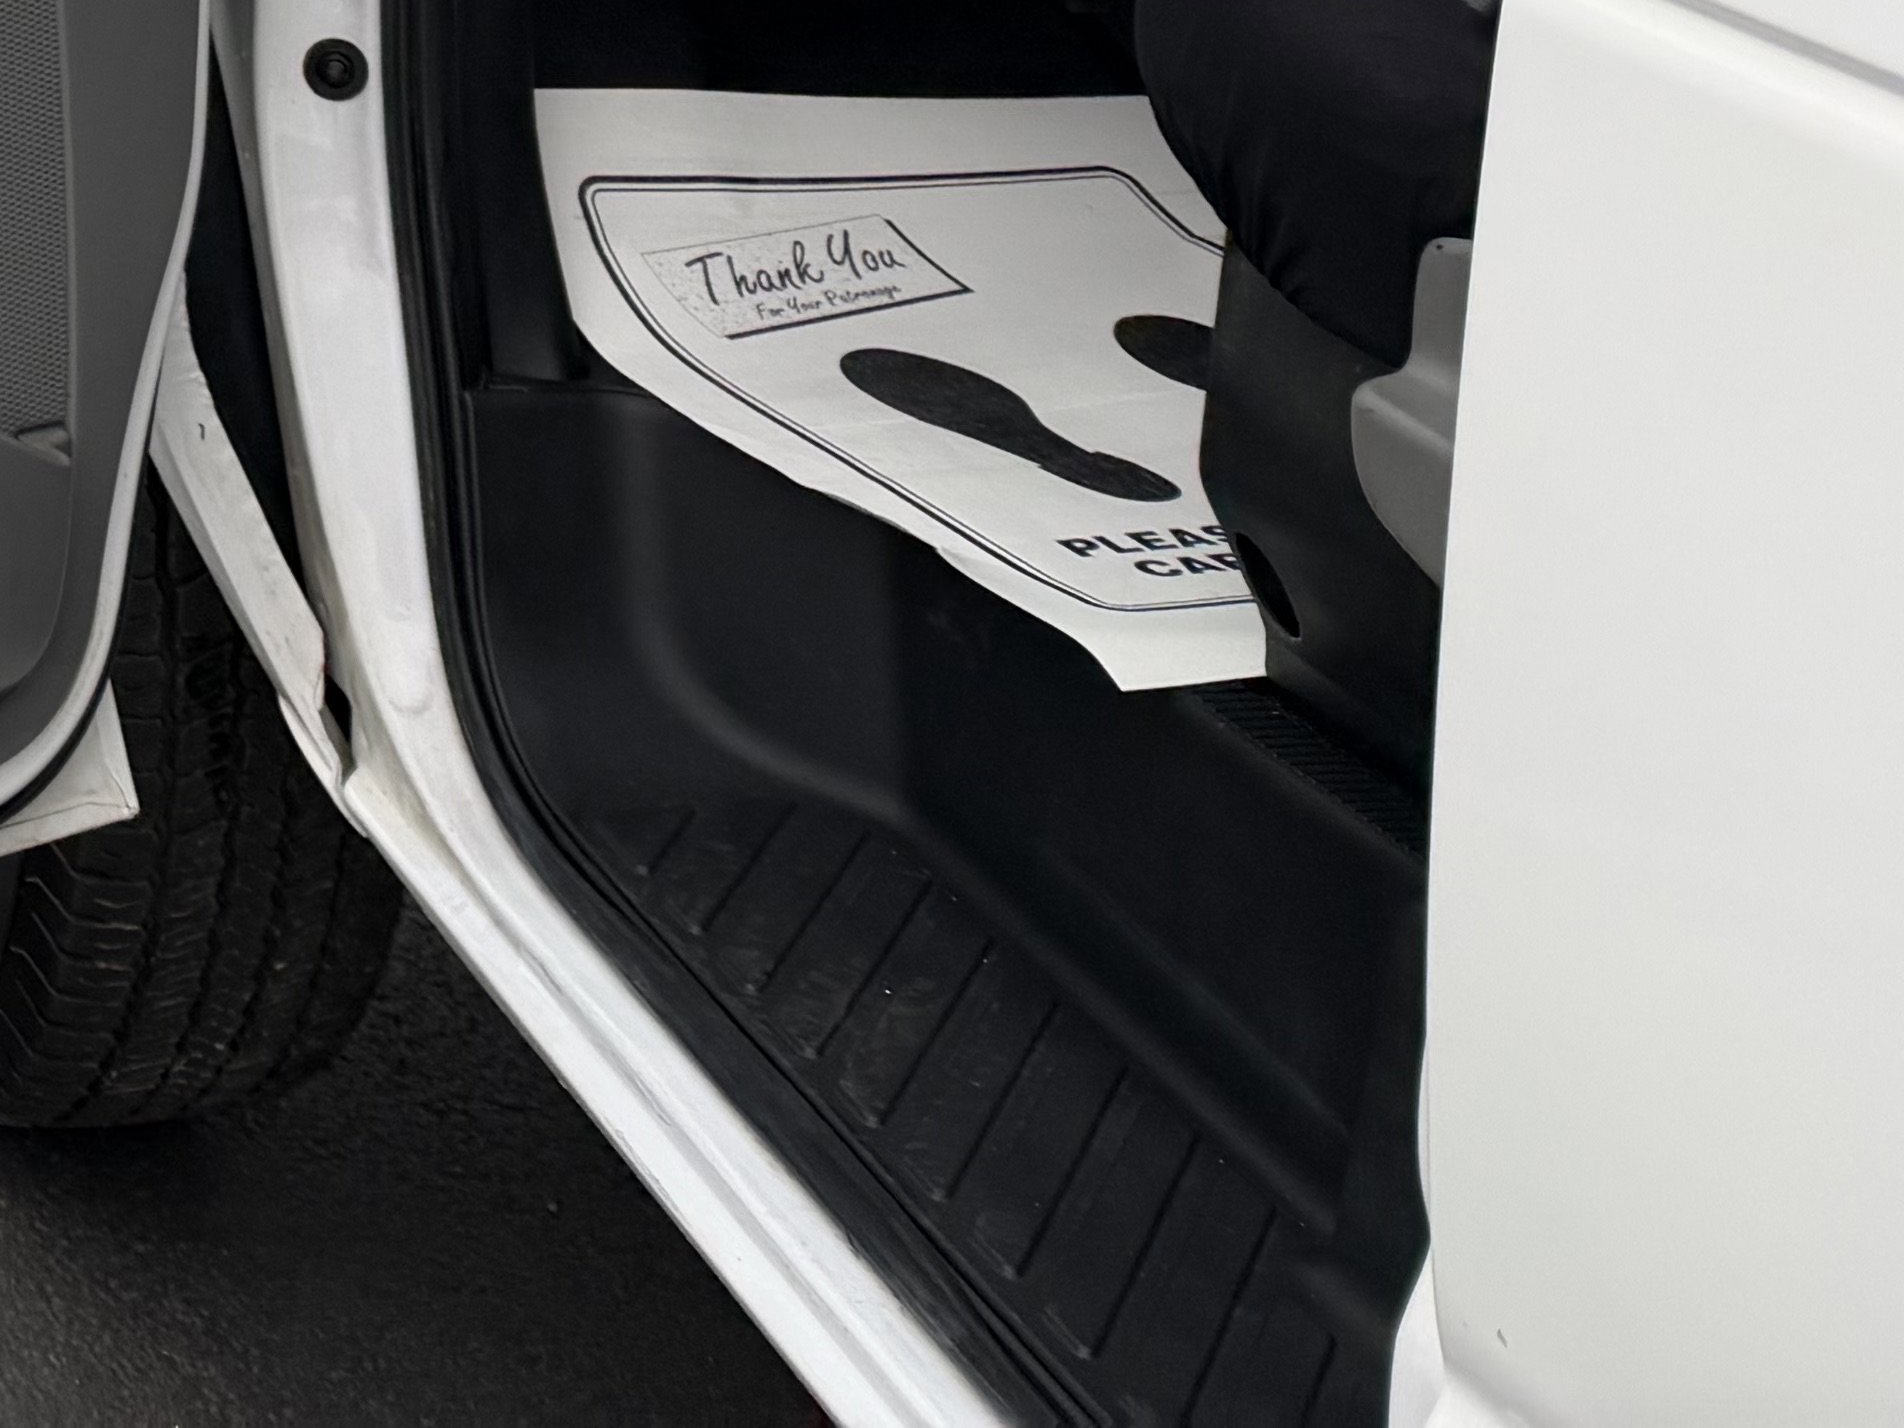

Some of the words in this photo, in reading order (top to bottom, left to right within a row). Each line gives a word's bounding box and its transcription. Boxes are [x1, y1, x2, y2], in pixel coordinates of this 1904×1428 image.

[684, 239, 825, 306] Thank
[826, 229, 907, 280] You
[755, 303, 784, 321] For
[787, 299, 822, 316] Your
[825, 285, 902, 307] Patronage
[1056, 524, 1229, 558] PLEAS
